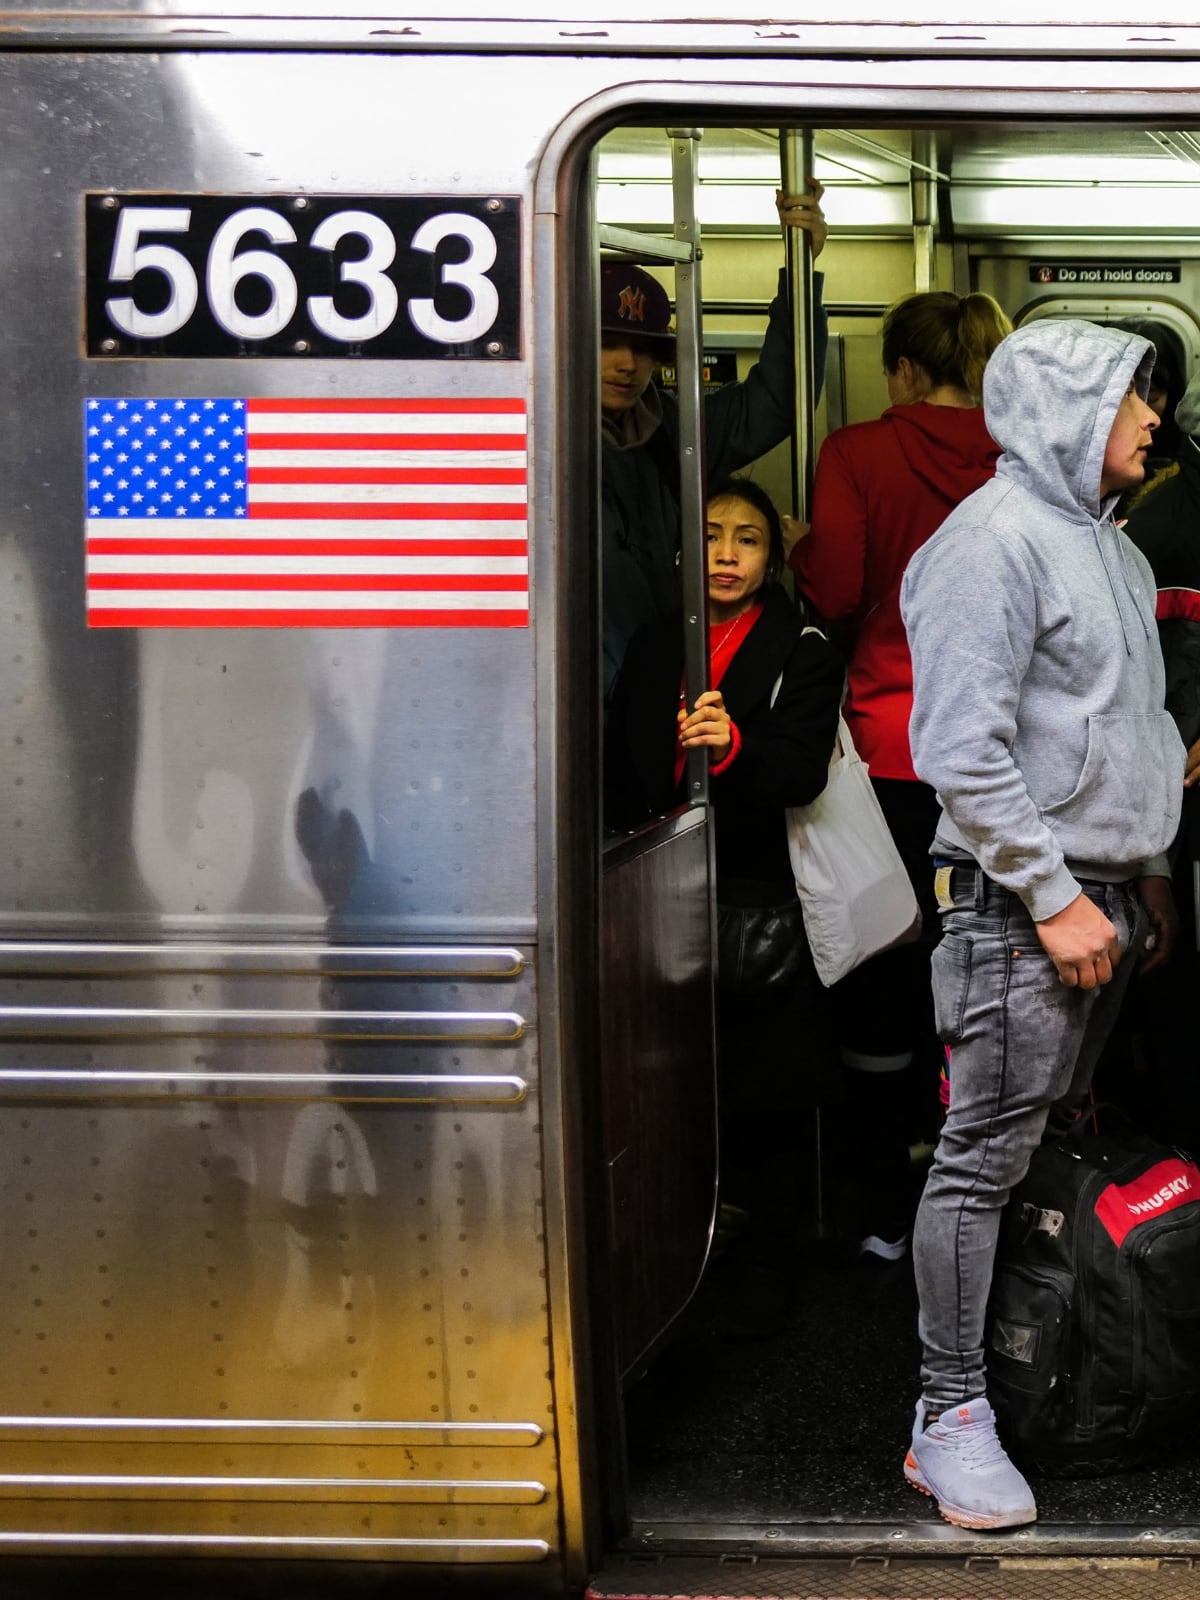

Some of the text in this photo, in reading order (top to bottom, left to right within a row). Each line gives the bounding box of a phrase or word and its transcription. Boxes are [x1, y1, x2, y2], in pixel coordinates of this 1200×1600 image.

[105, 207, 500, 343] 5633
[1058, 268, 1173, 281] Do not hold doors
[1136, 1174, 1189, 1212] HUSKY
